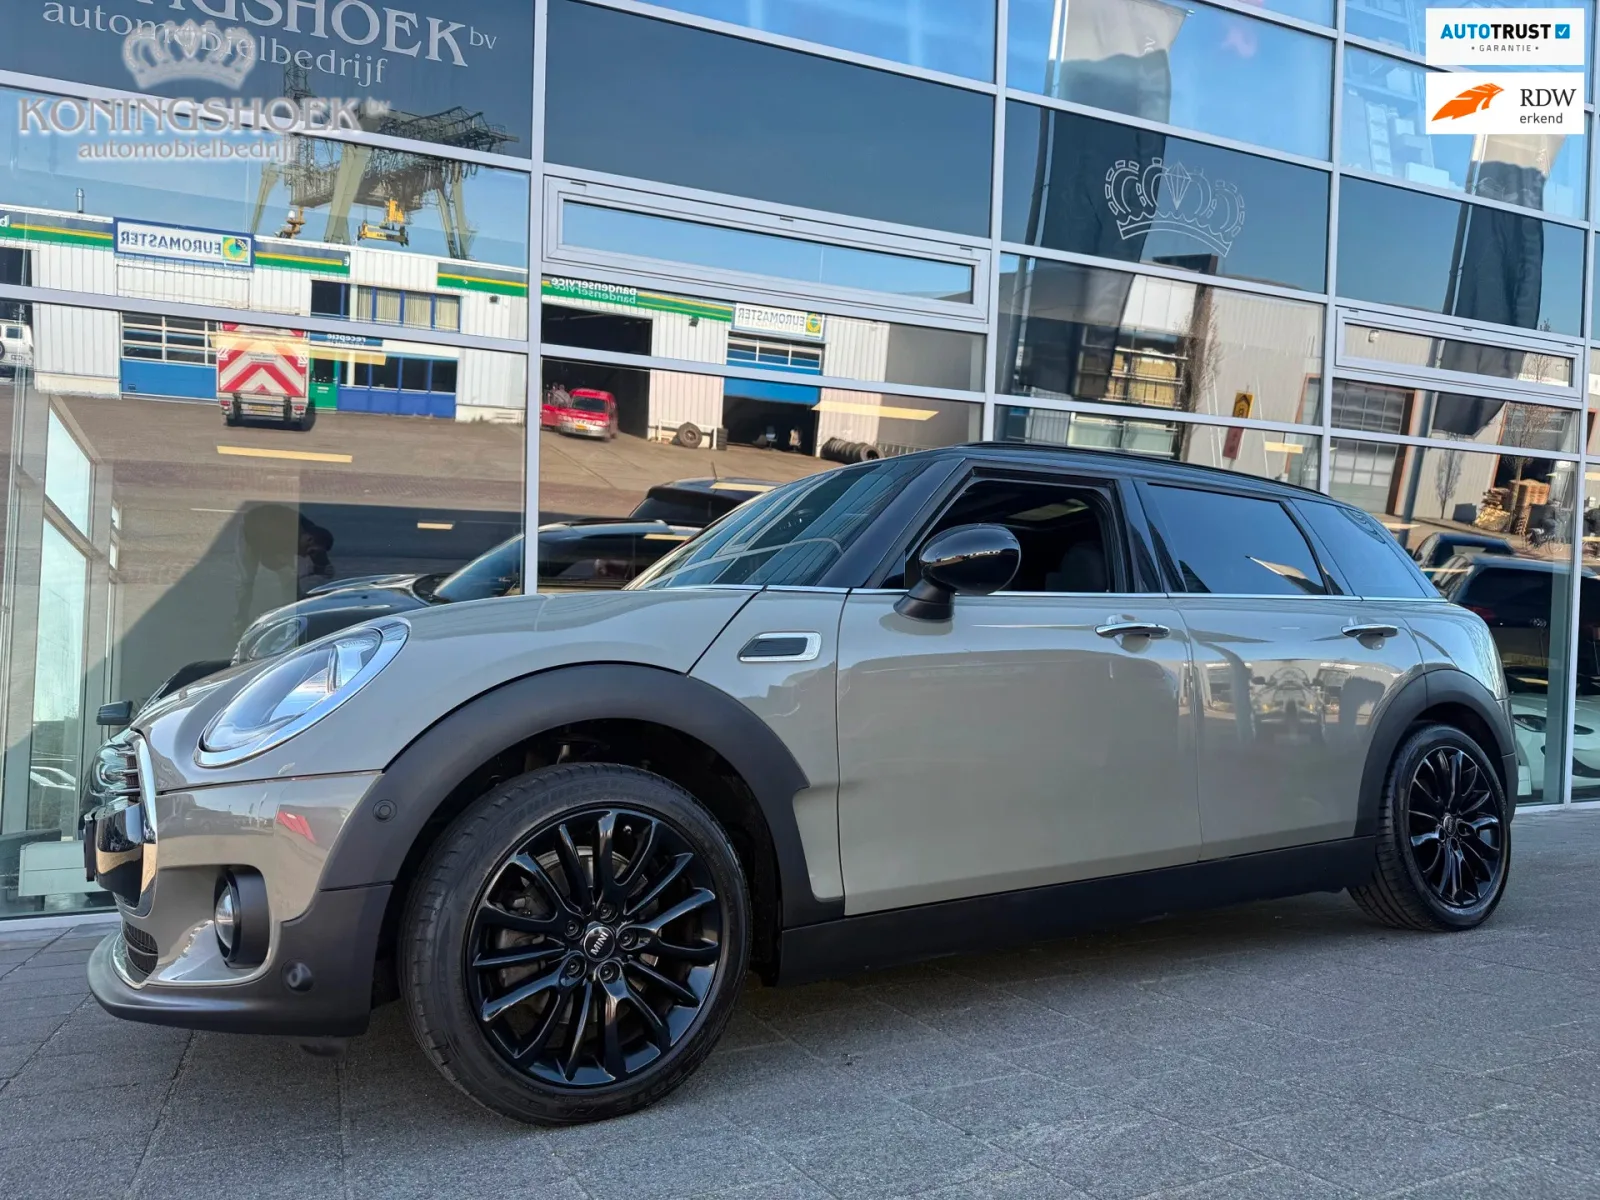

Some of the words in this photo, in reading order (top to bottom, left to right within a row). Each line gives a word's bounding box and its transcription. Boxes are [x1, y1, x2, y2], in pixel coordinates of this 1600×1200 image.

[42, 2, 388, 88] automobielbedrijf
[137, 0, 469, 68] SHOEK
[469, 26, 497, 50] bv
[590, 931, 609, 956] MINI
